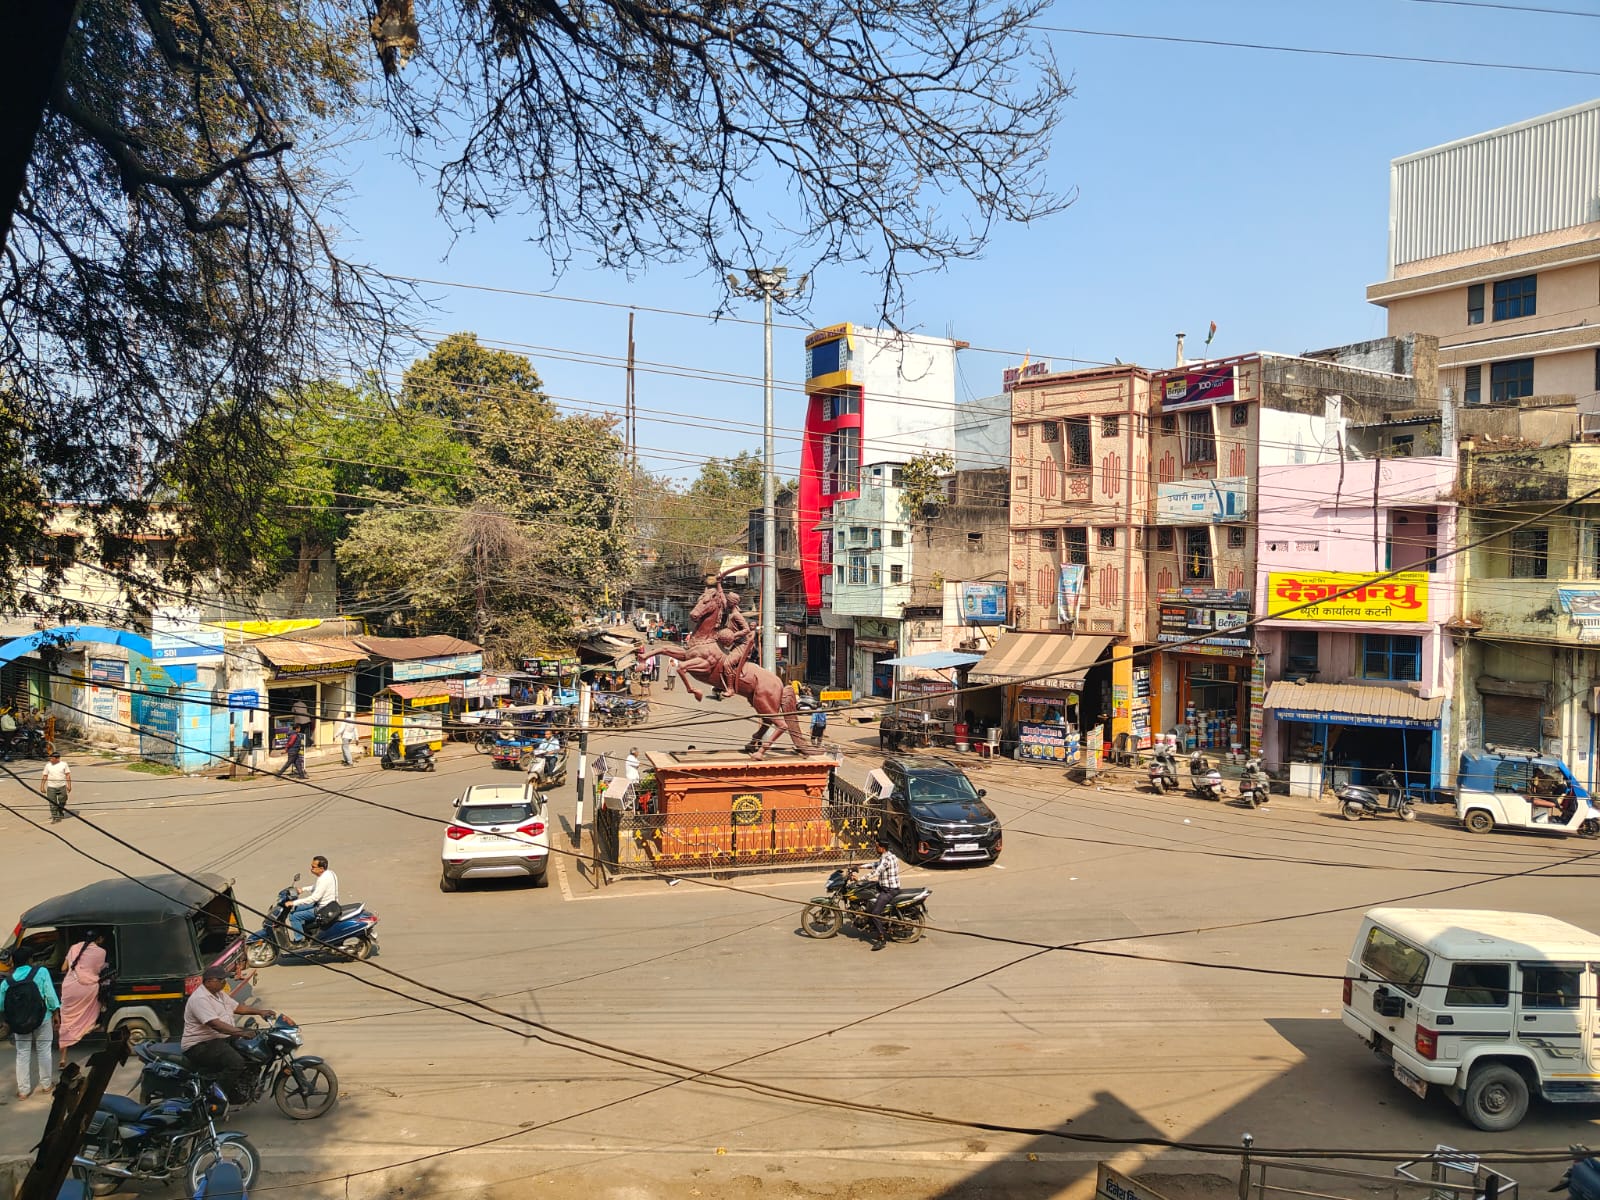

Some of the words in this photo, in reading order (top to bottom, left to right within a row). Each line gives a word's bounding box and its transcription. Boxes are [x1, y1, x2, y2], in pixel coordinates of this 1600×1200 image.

[1276, 579, 1423, 609] देशबन्धु
[1322, 604, 1361, 617] कार्यालय
[1364, 605, 1392, 618] कटनी
